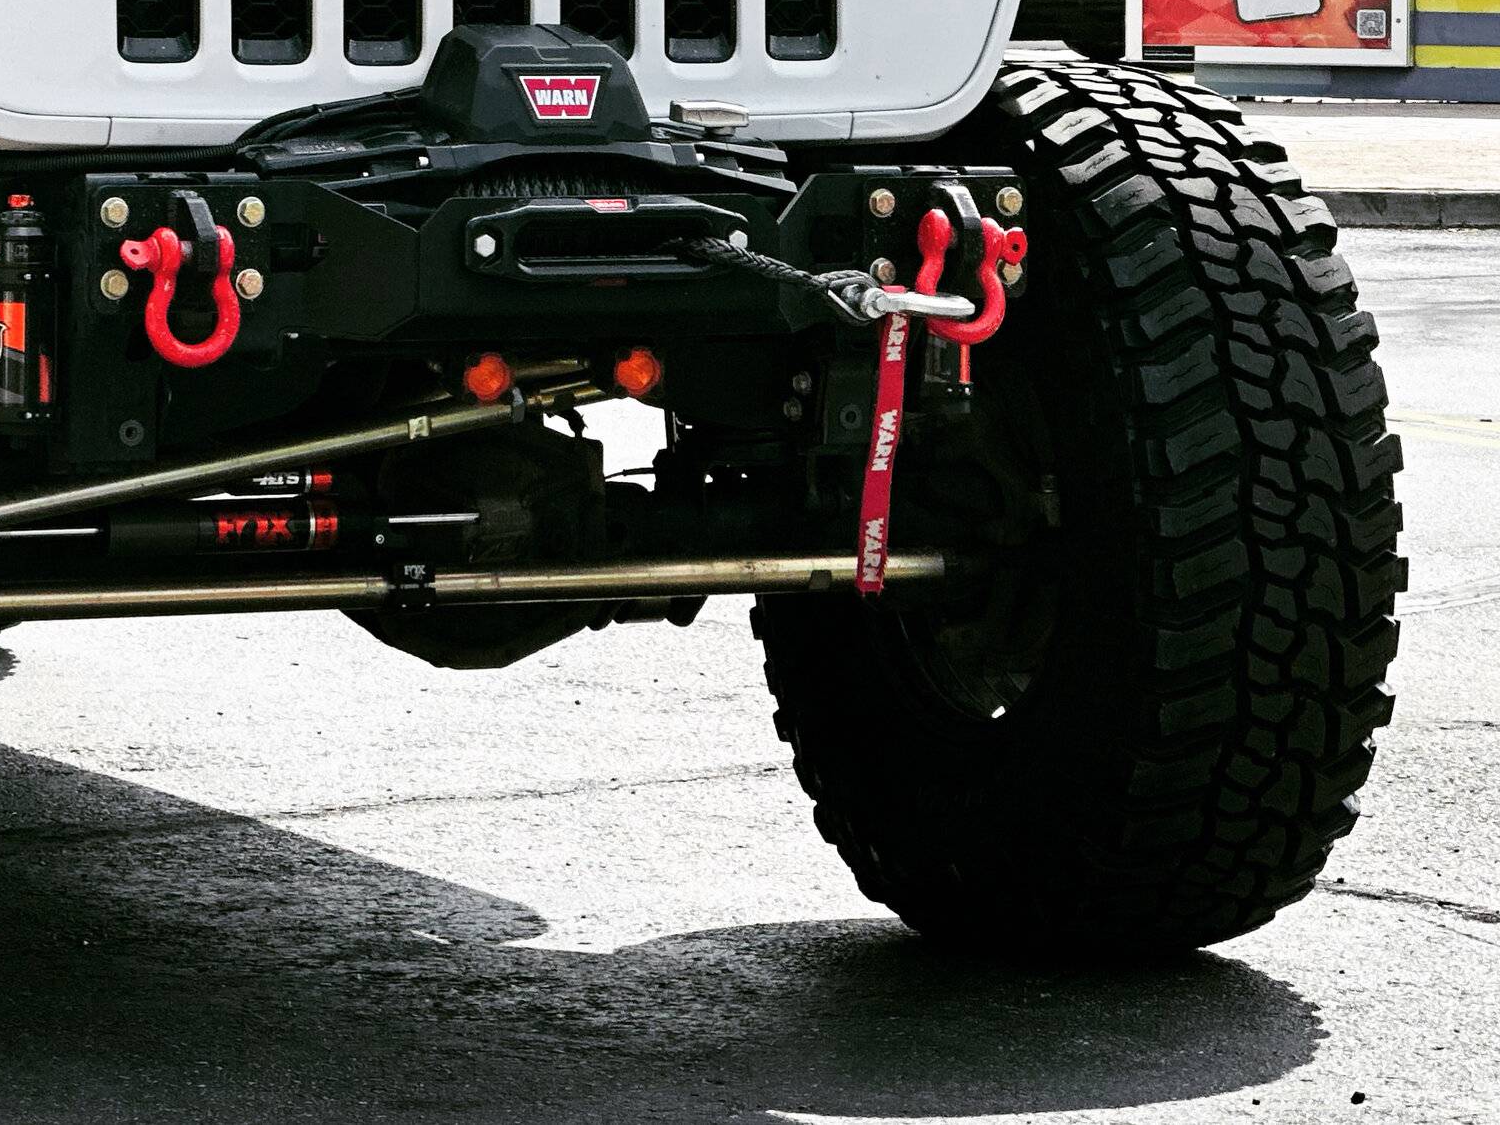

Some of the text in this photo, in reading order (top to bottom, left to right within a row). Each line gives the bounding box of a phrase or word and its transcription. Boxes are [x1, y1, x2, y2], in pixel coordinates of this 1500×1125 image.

[534, 89, 589, 106] WARN
[886, 313, 907, 362] ARN
[871, 409, 899, 472] WARN
[864, 517, 885, 582] WARN
